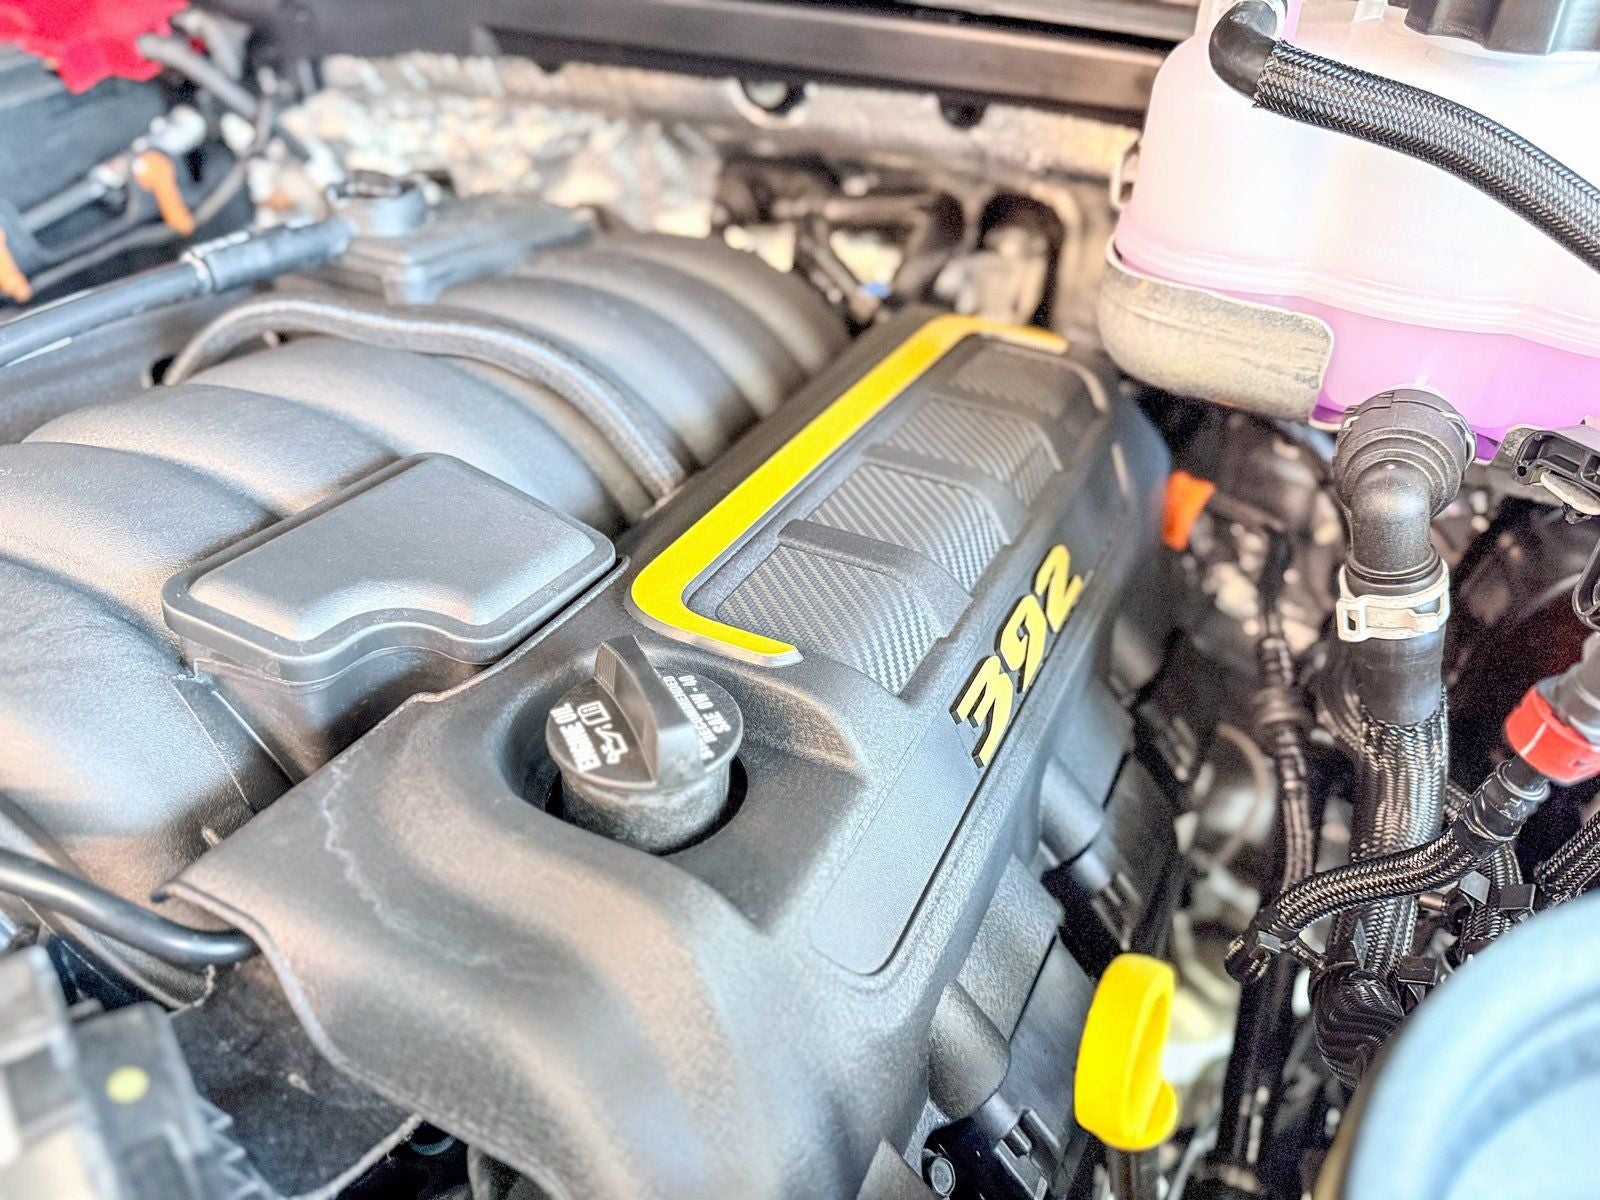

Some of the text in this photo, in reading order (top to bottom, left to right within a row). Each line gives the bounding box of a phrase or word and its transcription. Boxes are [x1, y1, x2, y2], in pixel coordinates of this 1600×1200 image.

[950, 543, 1084, 769] 392
[550, 702, 602, 773] ENGINE OIL
[702, 711, 732, 734] SAE
